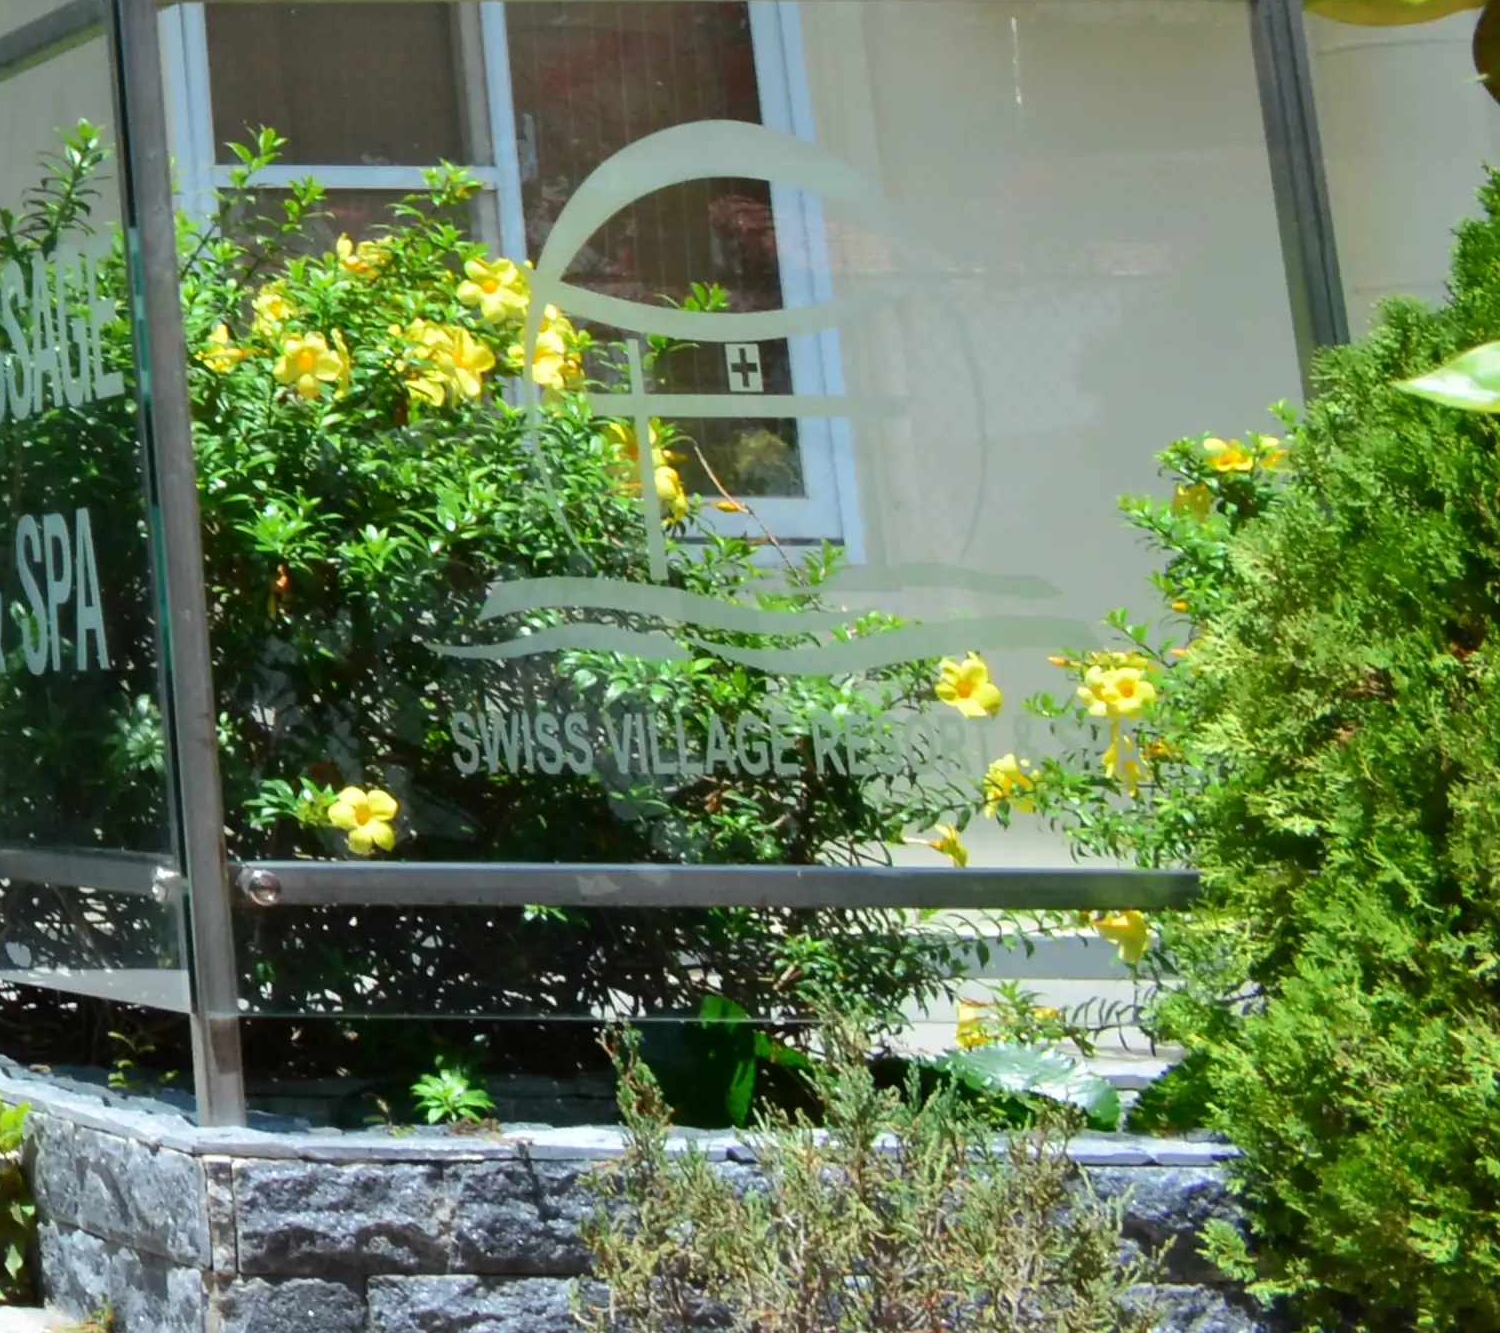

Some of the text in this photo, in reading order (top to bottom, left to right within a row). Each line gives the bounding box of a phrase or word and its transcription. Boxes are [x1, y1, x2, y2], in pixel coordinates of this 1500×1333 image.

[16, 508, 110, 676] SPA
[451, 711, 595, 775] SWISS
[603, 712, 798, 775] VILLAGE
[815, 713, 994, 775] RESORT
